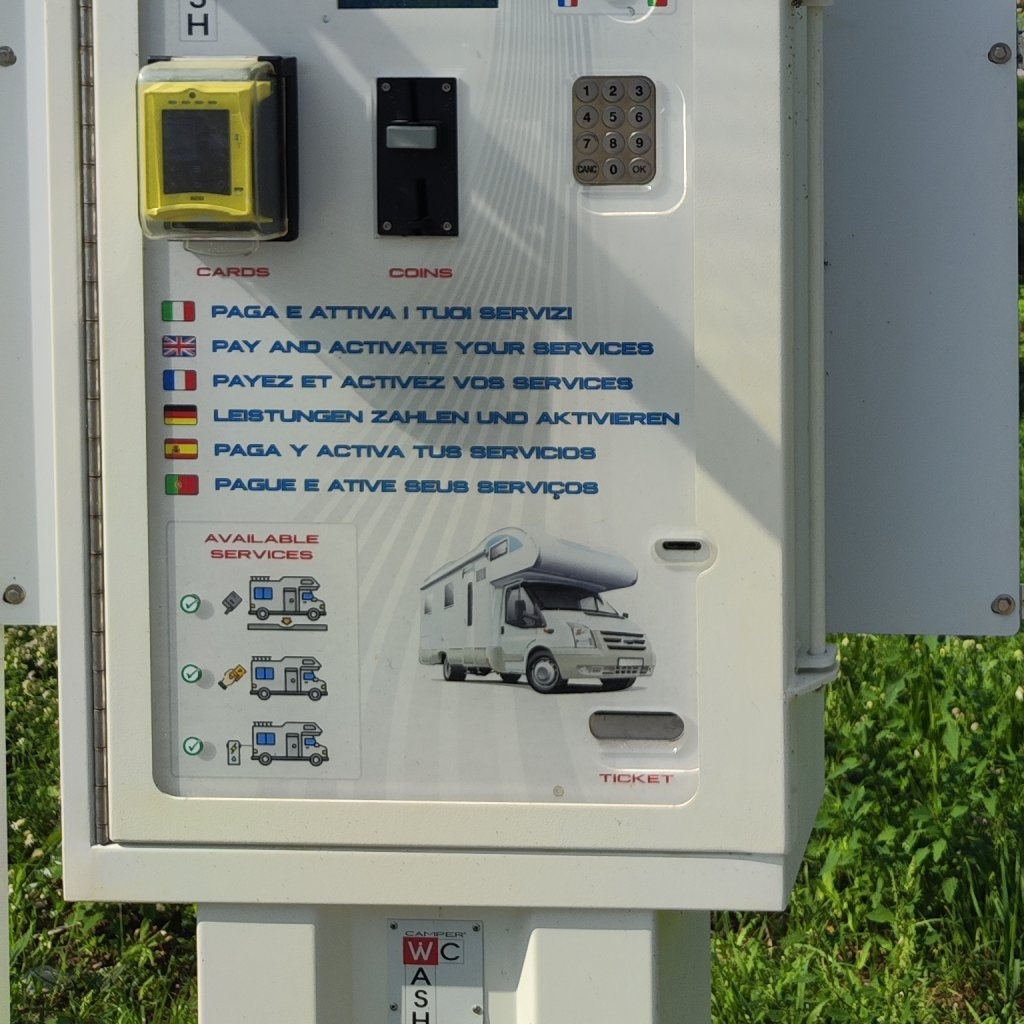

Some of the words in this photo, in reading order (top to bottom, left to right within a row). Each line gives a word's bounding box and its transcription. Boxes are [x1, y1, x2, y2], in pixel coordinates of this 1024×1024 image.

[583, 86, 589, 96] 1
[609, 85, 617, 96] 2
[635, 86, 643, 96] 3
[583, 112, 591, 122] 4
[609, 112, 617, 122] 5
[635, 112, 643, 122] 6
[583, 139, 591, 148] 7
[609, 138, 617, 148] 8
[635, 138, 643, 148] 9
[577, 165, 597, 174] CANC
[609, 164, 617, 175] 0
[632, 165, 646, 174] OK
[196, 267, 270, 277] CARDS
[388, 268, 453, 278] COINS
[211, 306, 279, 319] PAGA
[288, 306, 303, 319] E
[309, 306, 395, 320] ATTIVA
[418, 306, 472, 320] TUOI
[479, 306, 572, 321] SERVIZI
[211, 340, 264, 354] PAY
[269, 341, 321, 354] AND
[328, 341, 448, 355] ACTIVATE
[455, 342, 525, 355] YOUR
[530, 342, 655, 356] SERVICES
[213, 375, 294, 389] PAYEZ
[301, 375, 333, 389] ET
[340, 376, 446, 390] ACTIVEZ
[453, 376, 505, 390] VOS
[512, 376, 634, 391] SERVICES
[213, 410, 364, 424] LEISTUNGEN
[372, 411, 470, 424] ZAHLEN
[477, 411, 529, 425] UND
[536, 411, 680, 426] AKTIVIEREN
[214, 444, 282, 458] PAGA
[290, 445, 309, 458] Y
[317, 445, 405, 459] ACTIVA
[412, 445, 463, 459] TUS
[470, 445, 596, 460] SERVICIOS
[215, 479, 296, 492] PAGUE
[304, 479, 320, 492] E
[327, 479, 396, 493] ATIVE
[404, 480, 470, 494] SEUS
[477, 480, 599, 499] SERVIÇOS
[204, 533, 320, 545] AVAILABLE
[210, 549, 314, 560] SERVICES
[599, 773, 674, 784] TICKET
[408, 941, 460, 961] WC
